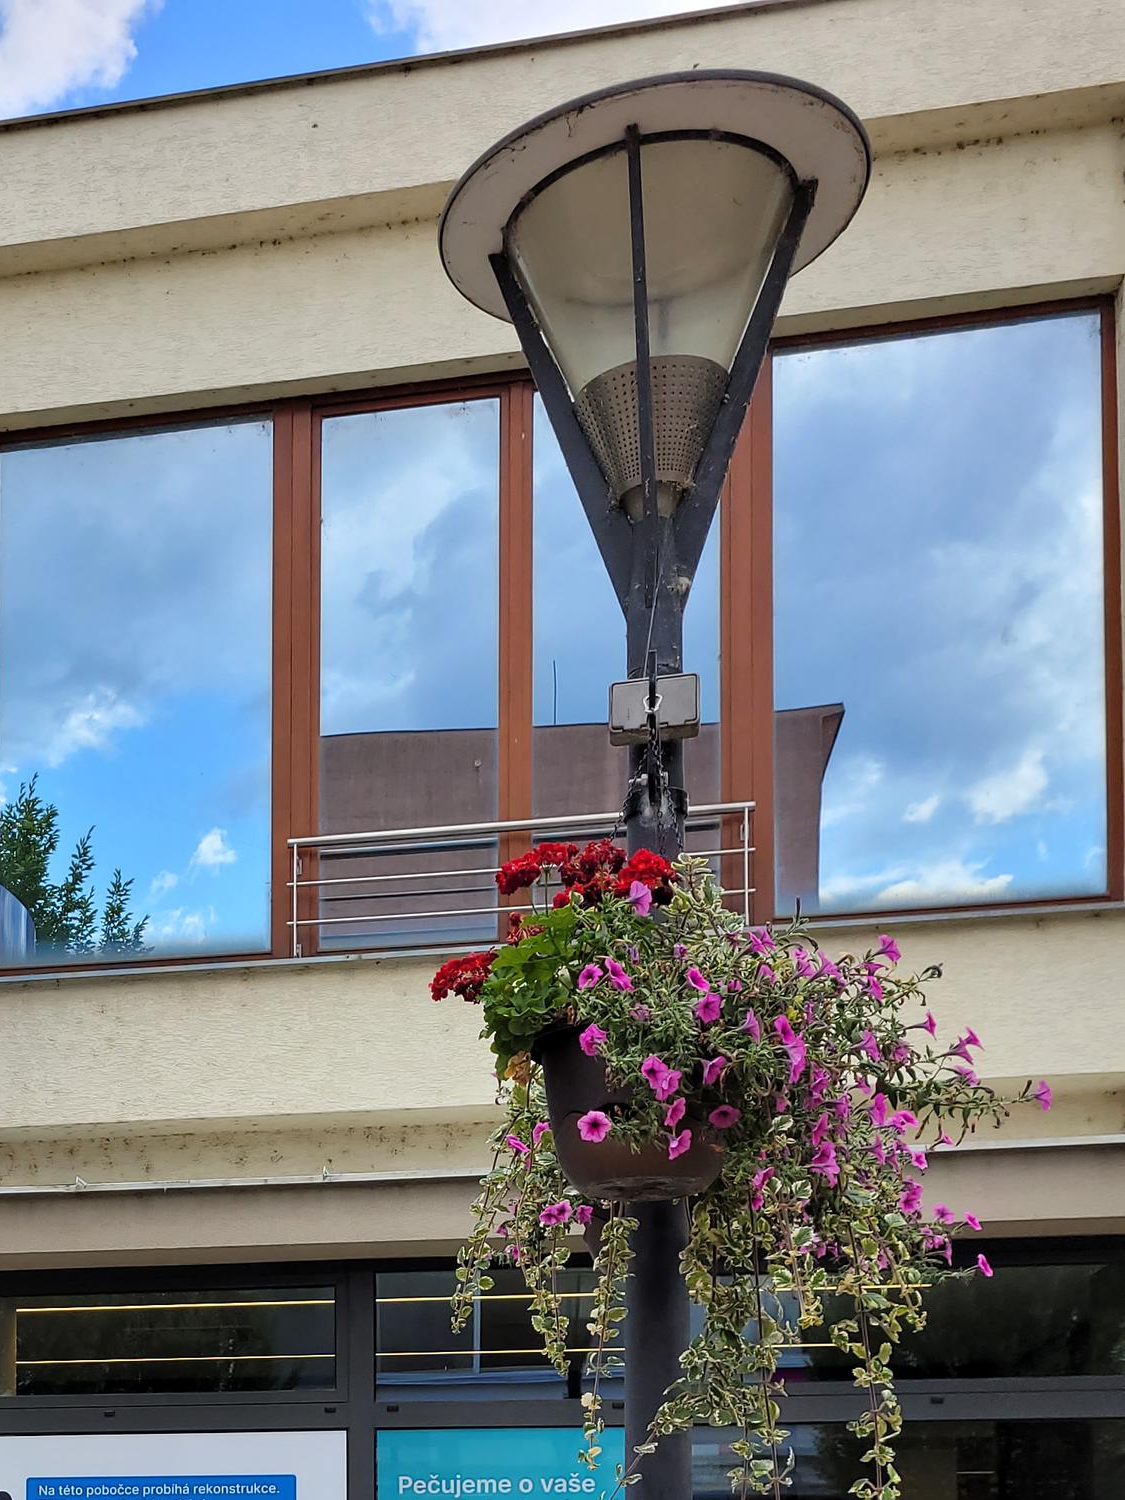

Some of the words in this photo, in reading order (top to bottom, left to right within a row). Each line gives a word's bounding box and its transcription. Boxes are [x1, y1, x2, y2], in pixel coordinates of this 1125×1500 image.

[38, 1485, 55, 1497] Na
[58, 1484, 83, 1496] této
[86, 1483, 140, 1498] pobočce
[142, 1483, 190, 1497] probíhá
[193, 1483, 280, 1495] rekonstrukce.
[398, 1474, 513, 1499] Pečujeme
[518, 1478, 534, 1493] o
[540, 1473, 596, 1493] vaše
